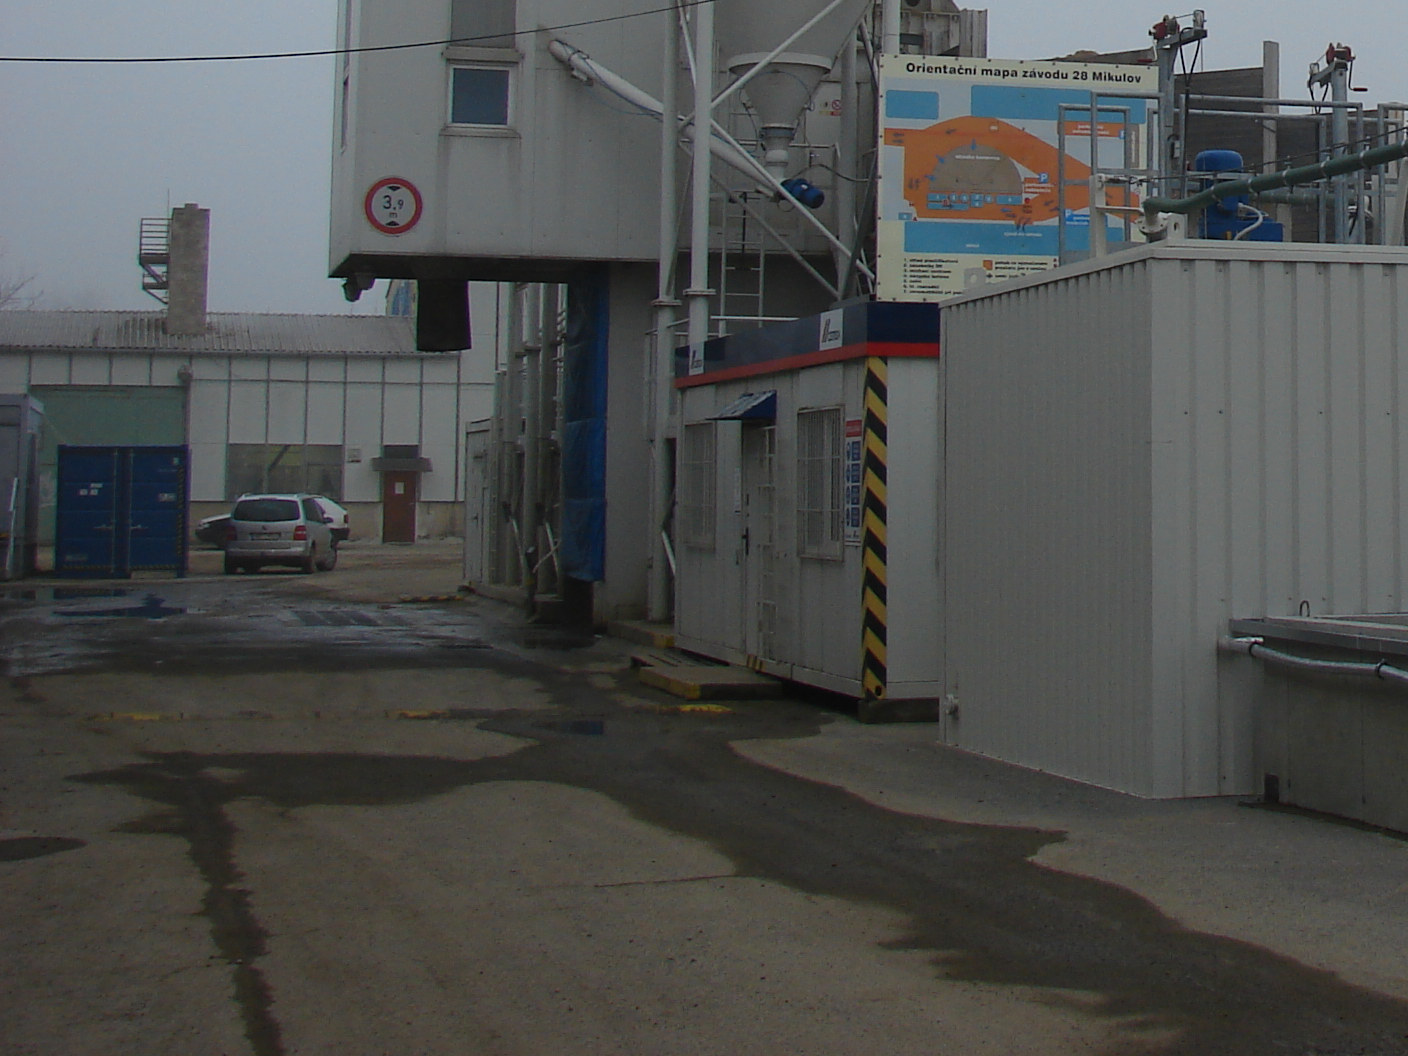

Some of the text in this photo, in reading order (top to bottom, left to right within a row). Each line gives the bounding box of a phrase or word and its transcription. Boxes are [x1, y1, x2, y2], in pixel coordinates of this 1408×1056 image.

[906, 62, 1142, 84] Orientační mapa závodu 28 Mikulov
